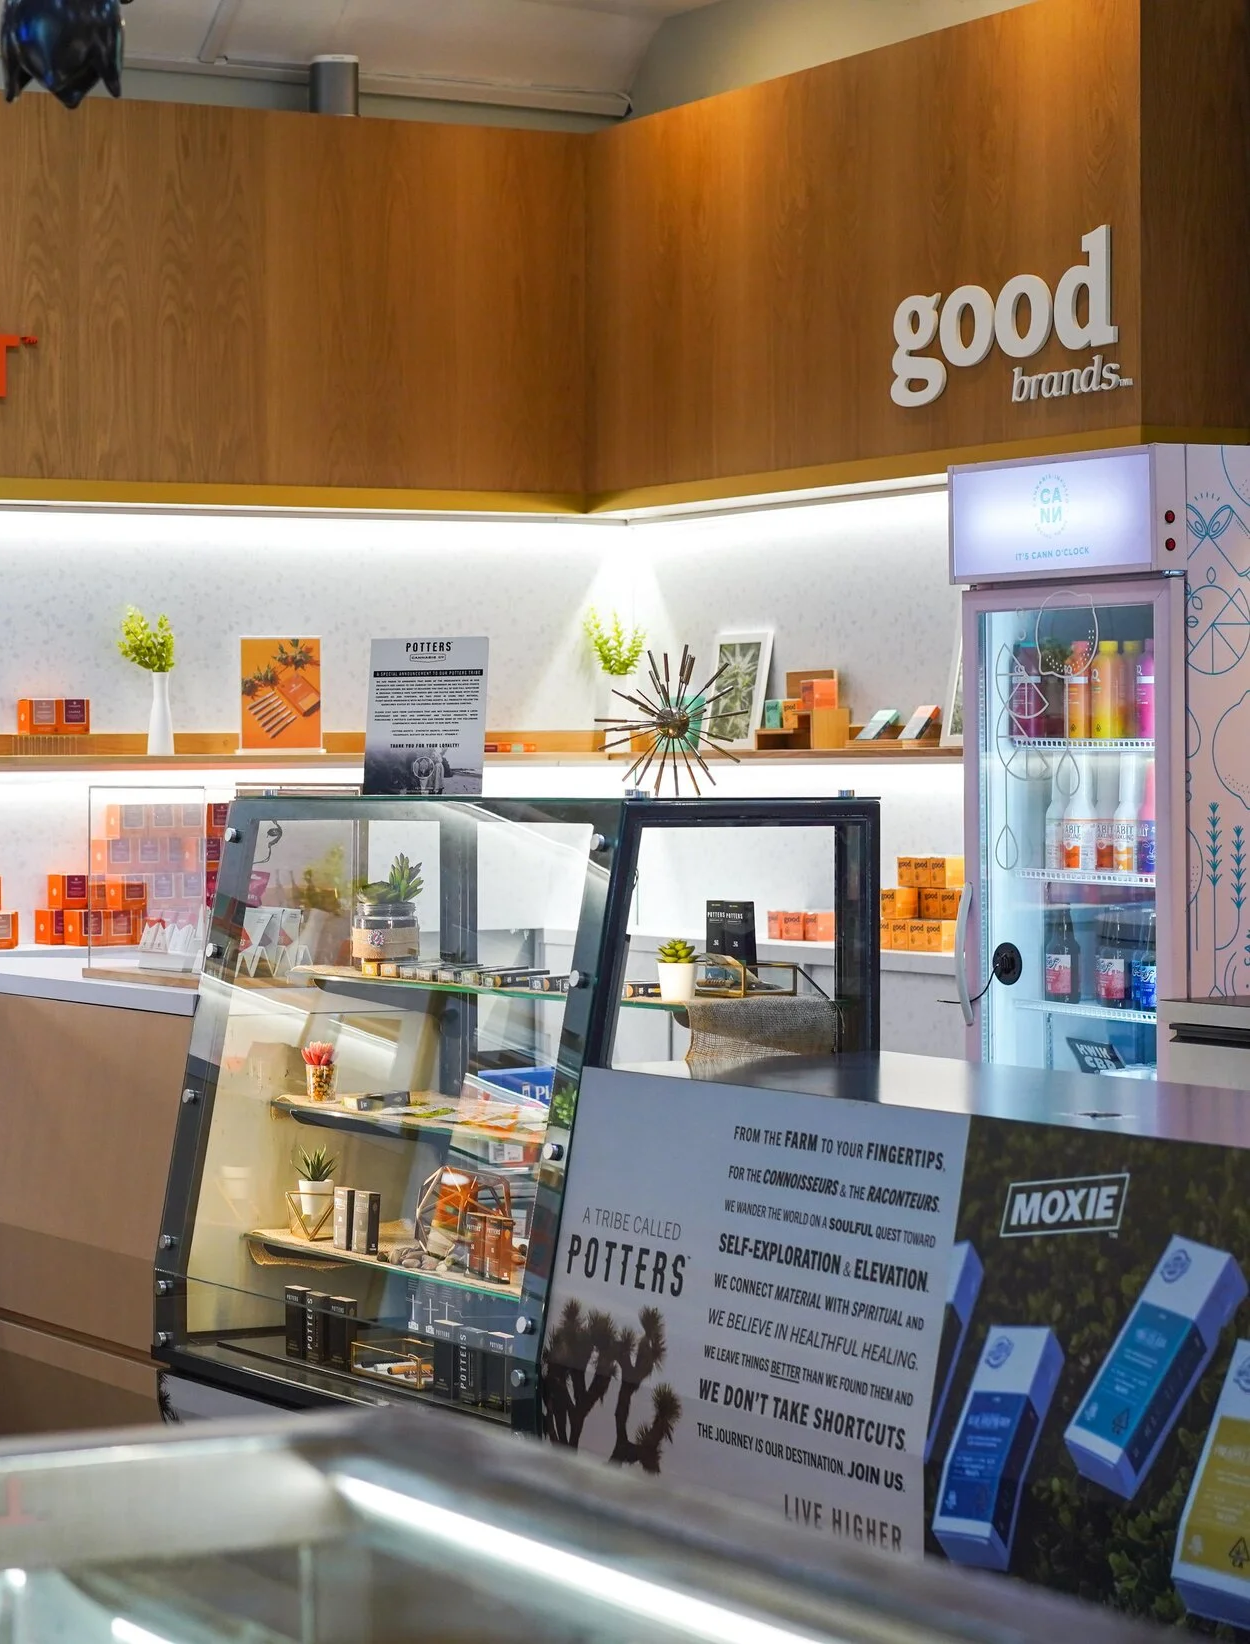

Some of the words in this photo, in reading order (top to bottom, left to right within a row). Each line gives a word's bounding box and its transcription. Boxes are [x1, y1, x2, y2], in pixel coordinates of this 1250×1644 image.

[890, 224, 1119, 408] good
[1011, 355, 1120, 402] brands
[1015, 552, 1029, 561] IT'S
[1031, 549, 1053, 560] CANN
[1055, 546, 1090, 557] O'CLOCK
[405, 642, 452, 652] POTTERS
[733, 1125, 760, 1144] FROM
[763, 1129, 783, 1147] THE
[784, 1130, 818, 1152] FARM
[821, 1138, 834, 1154] TO
[837, 1140, 869, 1159] YOUR
[728, 1165, 745, 1181] FOR
[746, 1168, 762, 1184] THE
[762, 1168, 839, 1197] CONNOISSEURS
[839, 1184, 847, 1198] &
[848, 1184, 866, 1200] THE
[1009, 1184, 1119, 1227] MOXIE
[582, 1207, 591, 1224] A
[595, 1208, 631, 1232] TRIBE
[633, 1215, 682, 1241] CALLED
[724, 1199, 736, 1213] WE
[736, 1200, 767, 1219] WANDER
[767, 1206, 781, 1221] THE
[782, 1208, 809, 1226] WORLD
[810, 1214, 821, 1227] ON
[821, 1215, 828, 1229] A
[828, 1217, 874, 1238] SOULFUL
[875, 1225, 902, 1243] QUEST
[902, 1229, 936, 1248] TOWARD
[566, 1234, 686, 1297] POTTERS
[718, 1232, 842, 1276] SELF-EXPLORATION
[842, 1261, 851, 1278] &
[714, 1272, 728, 1290] WE
[729, 1275, 774, 1299] CONNECT
[774, 1285, 821, 1309] MATERIAL
[824, 1295, 850, 1315] WITH
[851, 1301, 903, 1327] SPIRITUAL
[905, 1315, 924, 1331] AND
[708, 1307, 724, 1327] WE
[726, 1312, 773, 1337] BELIEVE
[774, 1323, 789, 1341] IN
[789, 1326, 858, 1357] HEALTHFUL
[860, 1343, 919, 1371] HEALING.
[703, 1344, 716, 1360] WE
[716, 1347, 740, 1365] LEAVE
[741, 1352, 770, 1373] THINGS
[769, 1360, 800, 1381] BETTER
[801, 1367, 824, 1386] THAN
[825, 1372, 838, 1389] WE
[839, 1376, 868, 1396] FOUND
[869, 1383, 894, 1402] THEM
[894, 1389, 914, 1407] AND
[699, 1378, 719, 1403] WE
[723, 1383, 769, 1415] DON'T
[772, 1396, 810, 1426] TAKE
[696, 1422, 713, 1440] THE
[714, 1425, 754, 1451] JOURNEY
[755, 1437, 764, 1454] IS
[765, 1440, 784, 1460] OUR
[785, 1445, 846, 1476] DESTINATION.
[847, 1461, 881, 1486] JOIN
[883, 1470, 906, 1493] US.
[784, 1493, 823, 1531] LIVE
